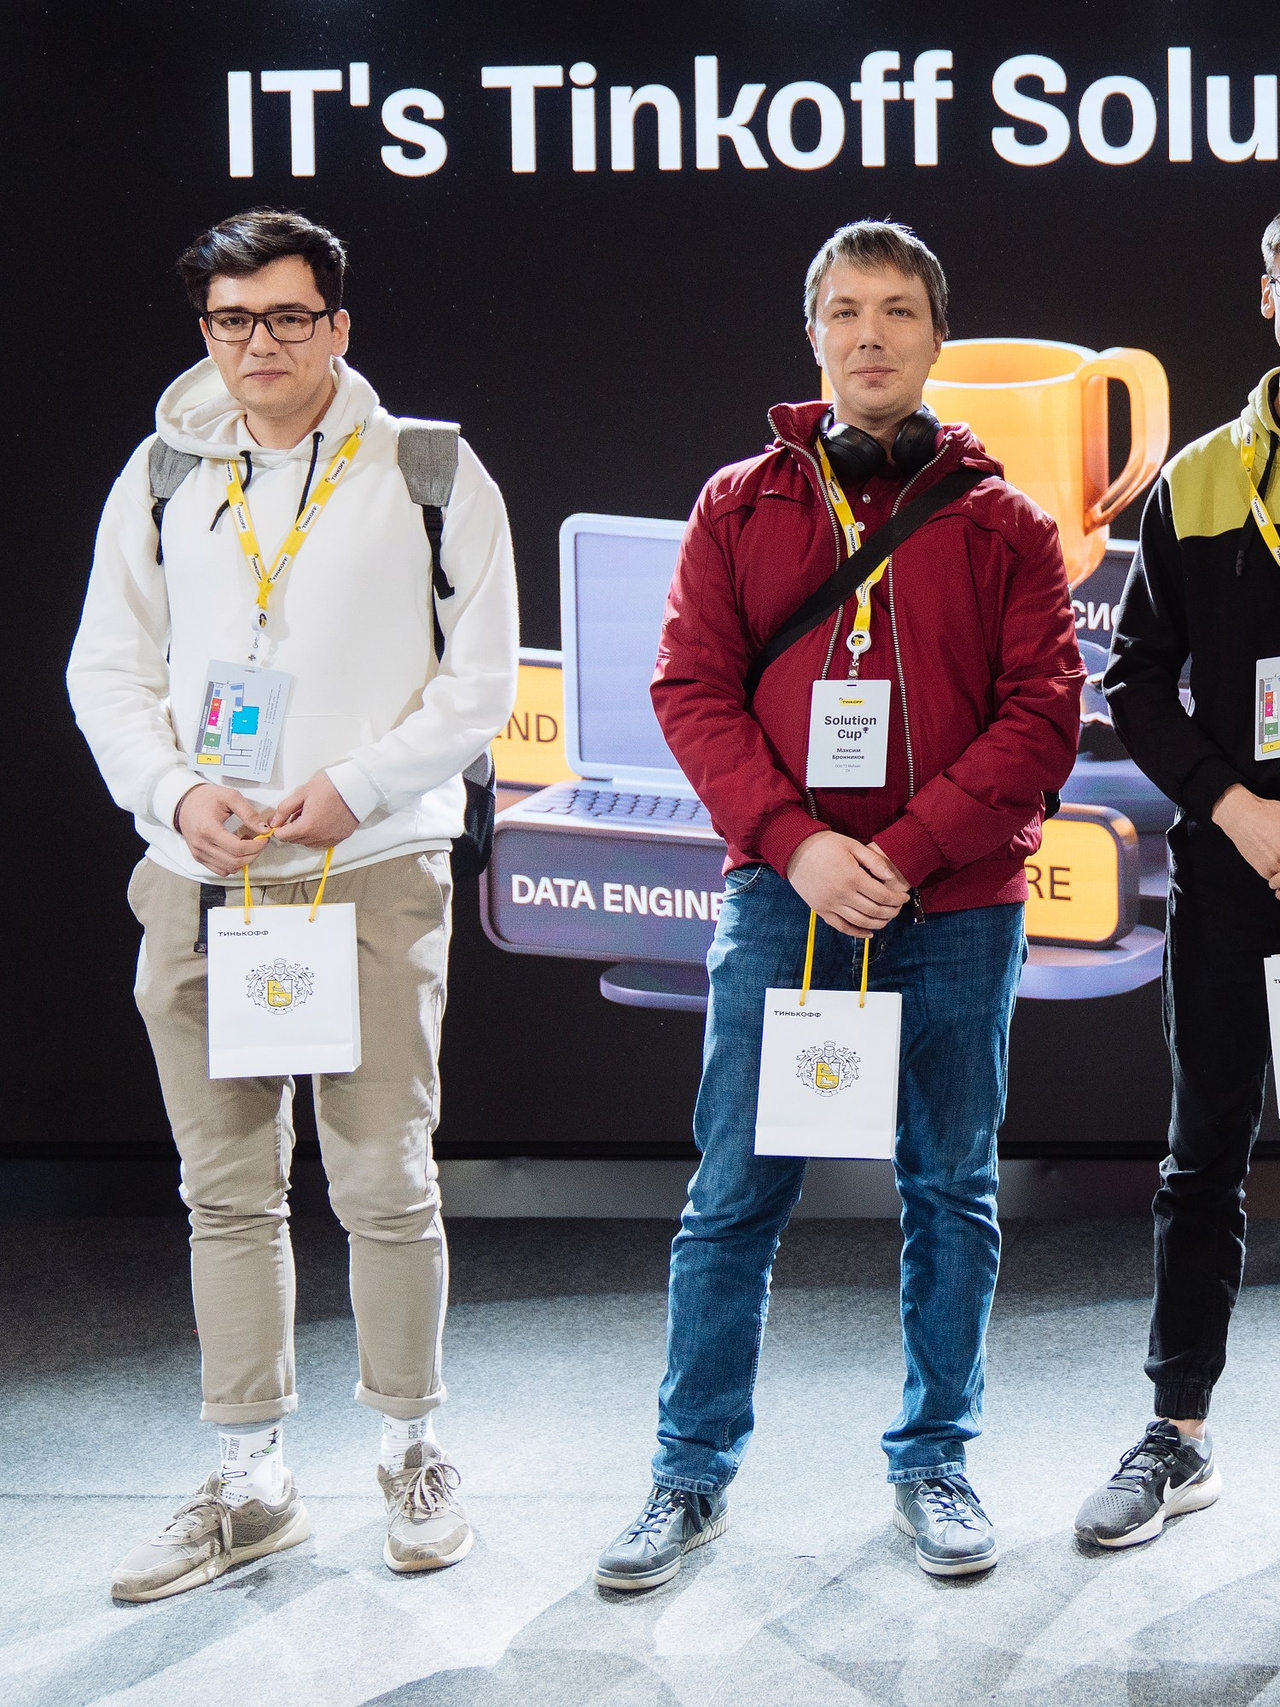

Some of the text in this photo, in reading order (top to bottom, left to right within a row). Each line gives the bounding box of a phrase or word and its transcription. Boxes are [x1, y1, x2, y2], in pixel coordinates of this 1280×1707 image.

[228, 62, 446, 176] IT's
[482, 50, 951, 171] Tinkoff
[331, 459, 346, 481] TINKOFF
[302, 506, 318, 529] TINKOFF
[273, 556, 288, 581] TINKOFF
[824, 715, 877, 726] Solution
[837, 729, 862, 741] Cup
[511, 874, 596, 910] DATA
[774, 1010, 822, 1018] ТИНЬКОФФ
